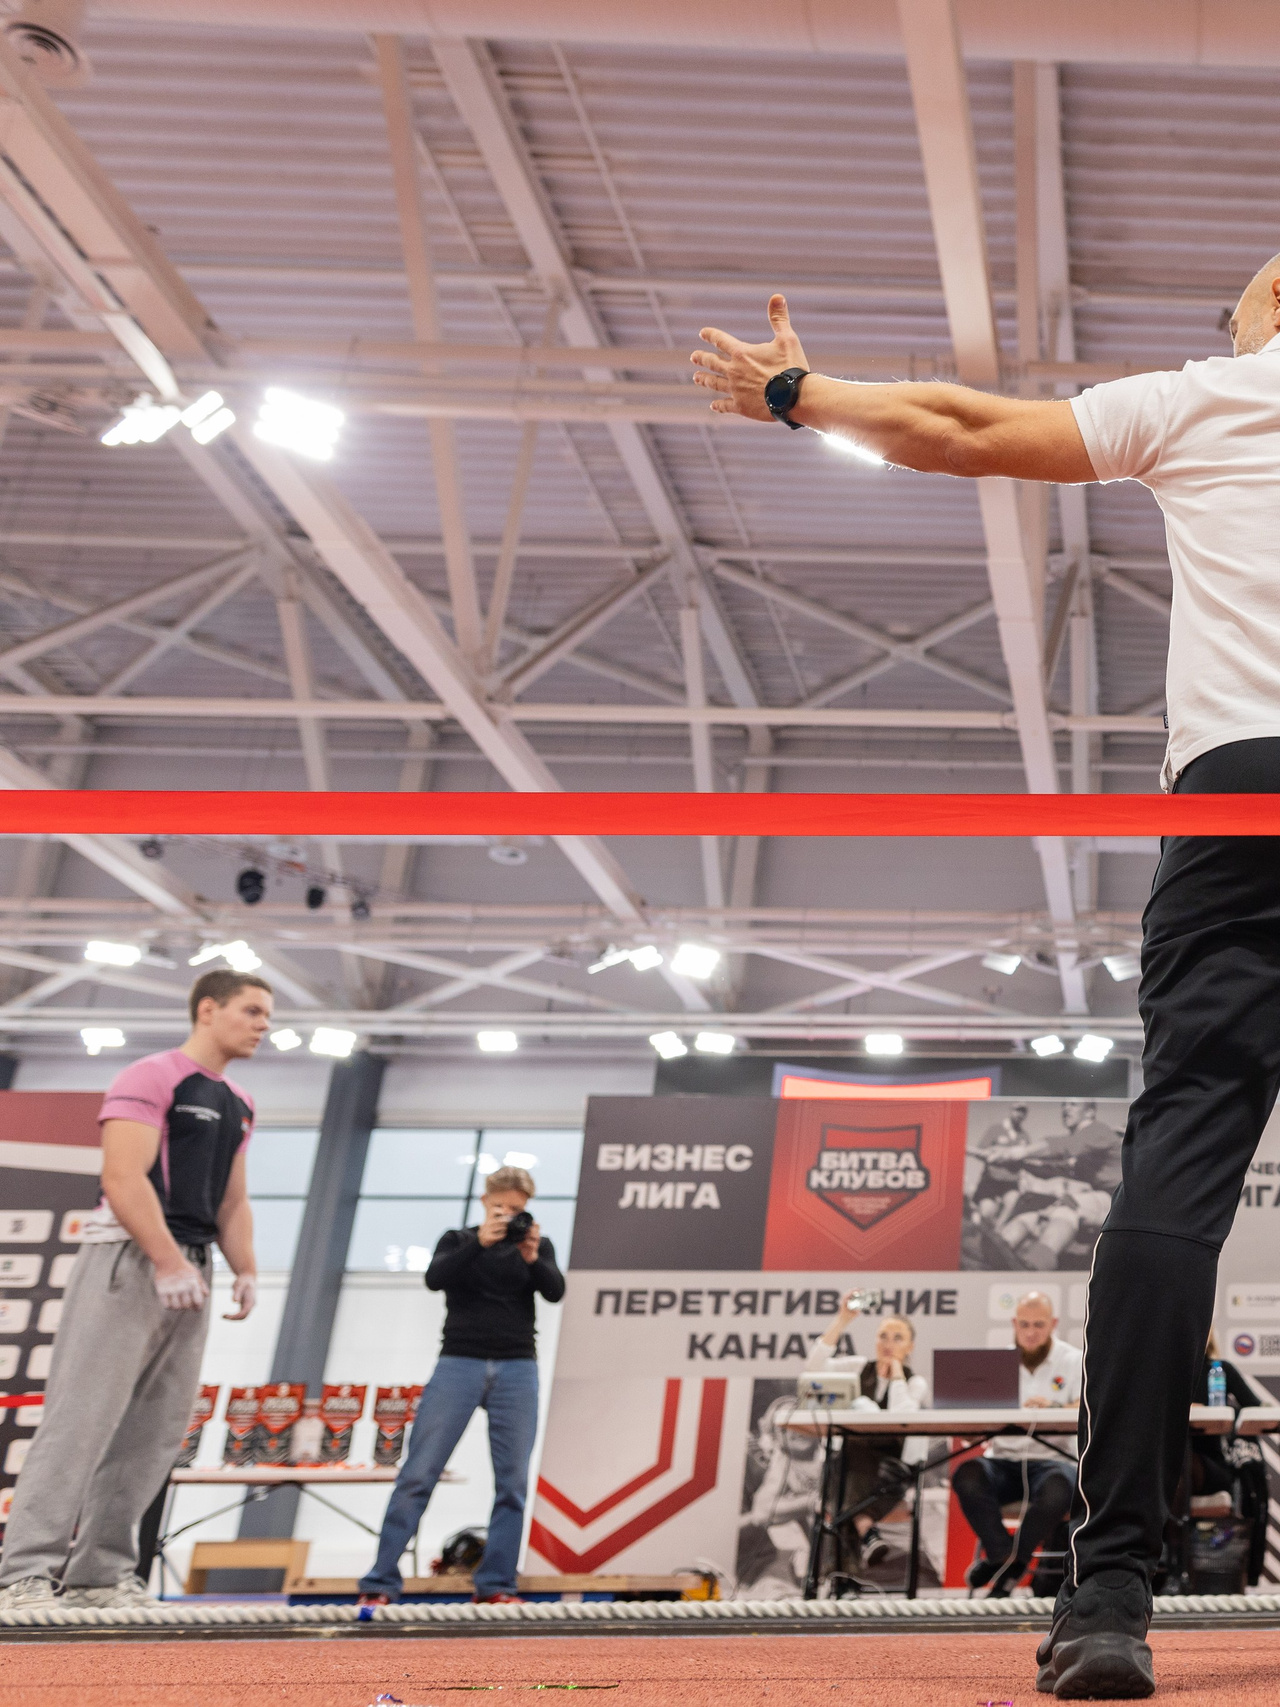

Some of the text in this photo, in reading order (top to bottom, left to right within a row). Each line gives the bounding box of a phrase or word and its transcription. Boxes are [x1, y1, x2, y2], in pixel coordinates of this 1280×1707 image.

[596, 1143, 754, 1172] БИЗНЕС
[820, 1151, 919, 1170] БИТВА
[809, 1169, 926, 1190] КЛУБОВ
[617, 1181, 721, 1210] ЛИГА
[593, 1288, 958, 1316] ПЕРЕТЯГИВНИЕ
